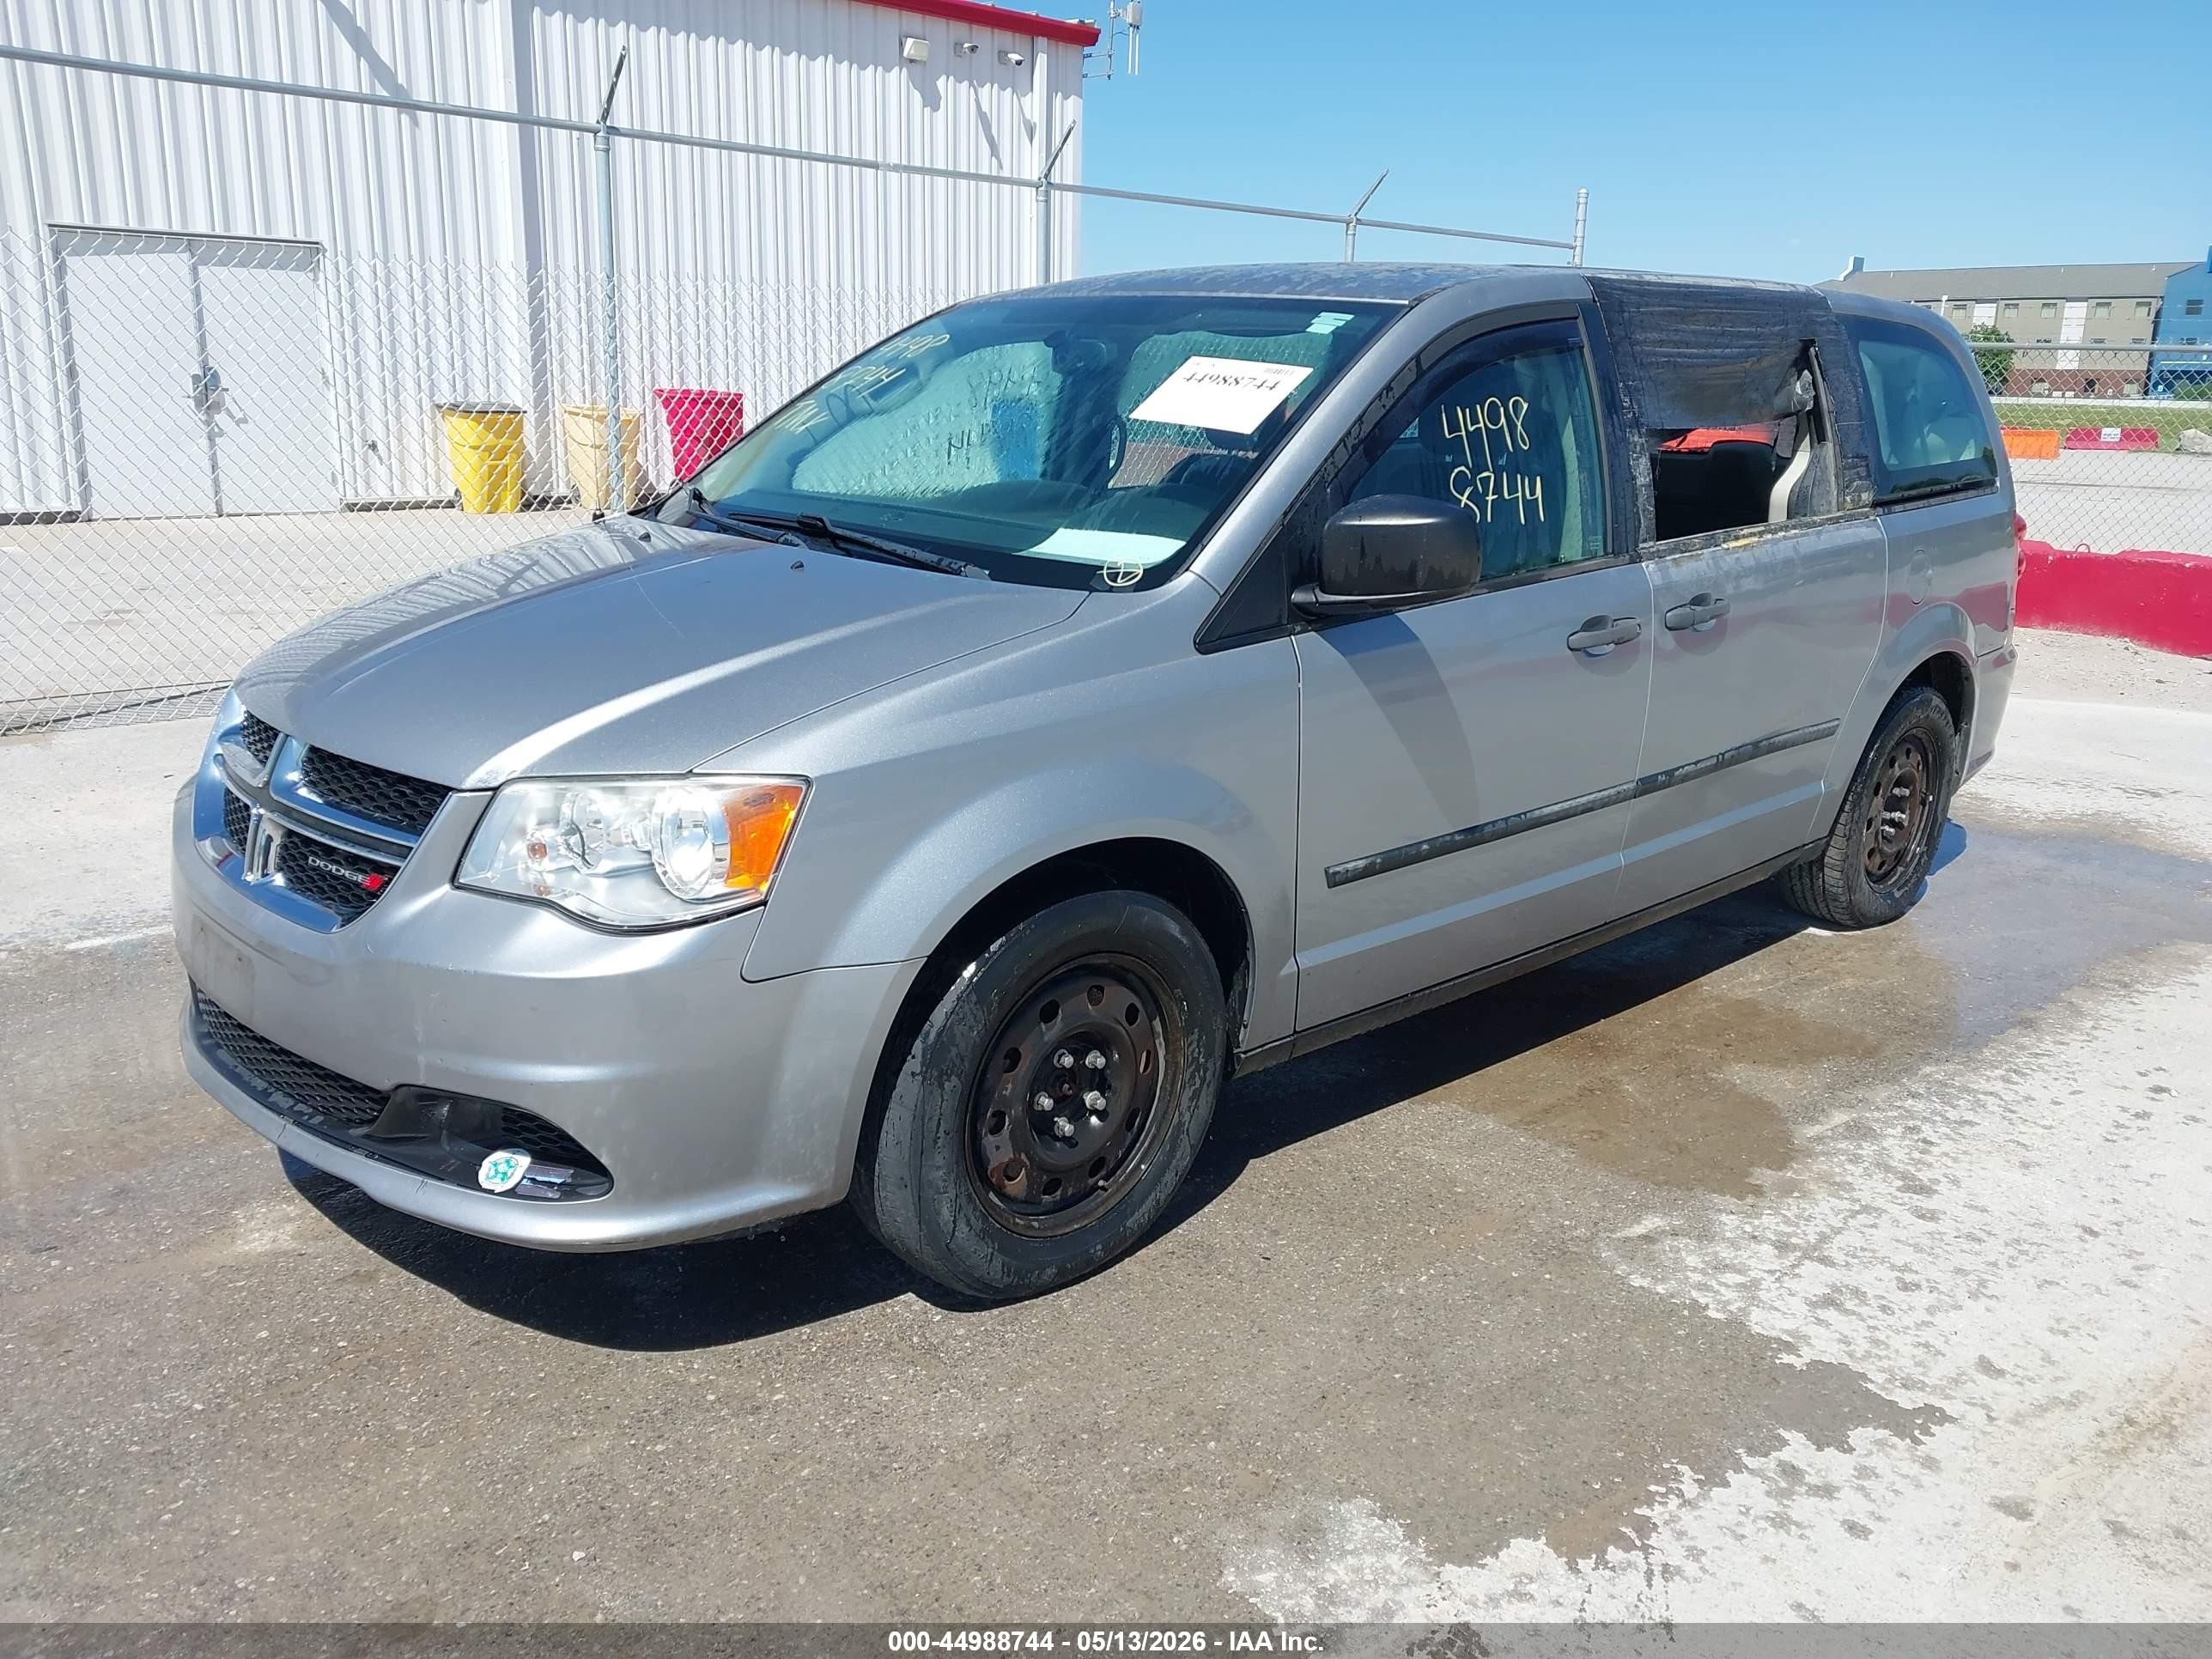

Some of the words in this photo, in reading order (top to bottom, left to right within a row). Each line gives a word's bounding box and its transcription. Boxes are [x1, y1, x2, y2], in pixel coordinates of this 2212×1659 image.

[1182, 371, 1282, 391] 44988744
[1441, 396, 1529, 471] 4498
[1449, 465, 1545, 525] 8744
[308, 856, 371, 887] DODGE
